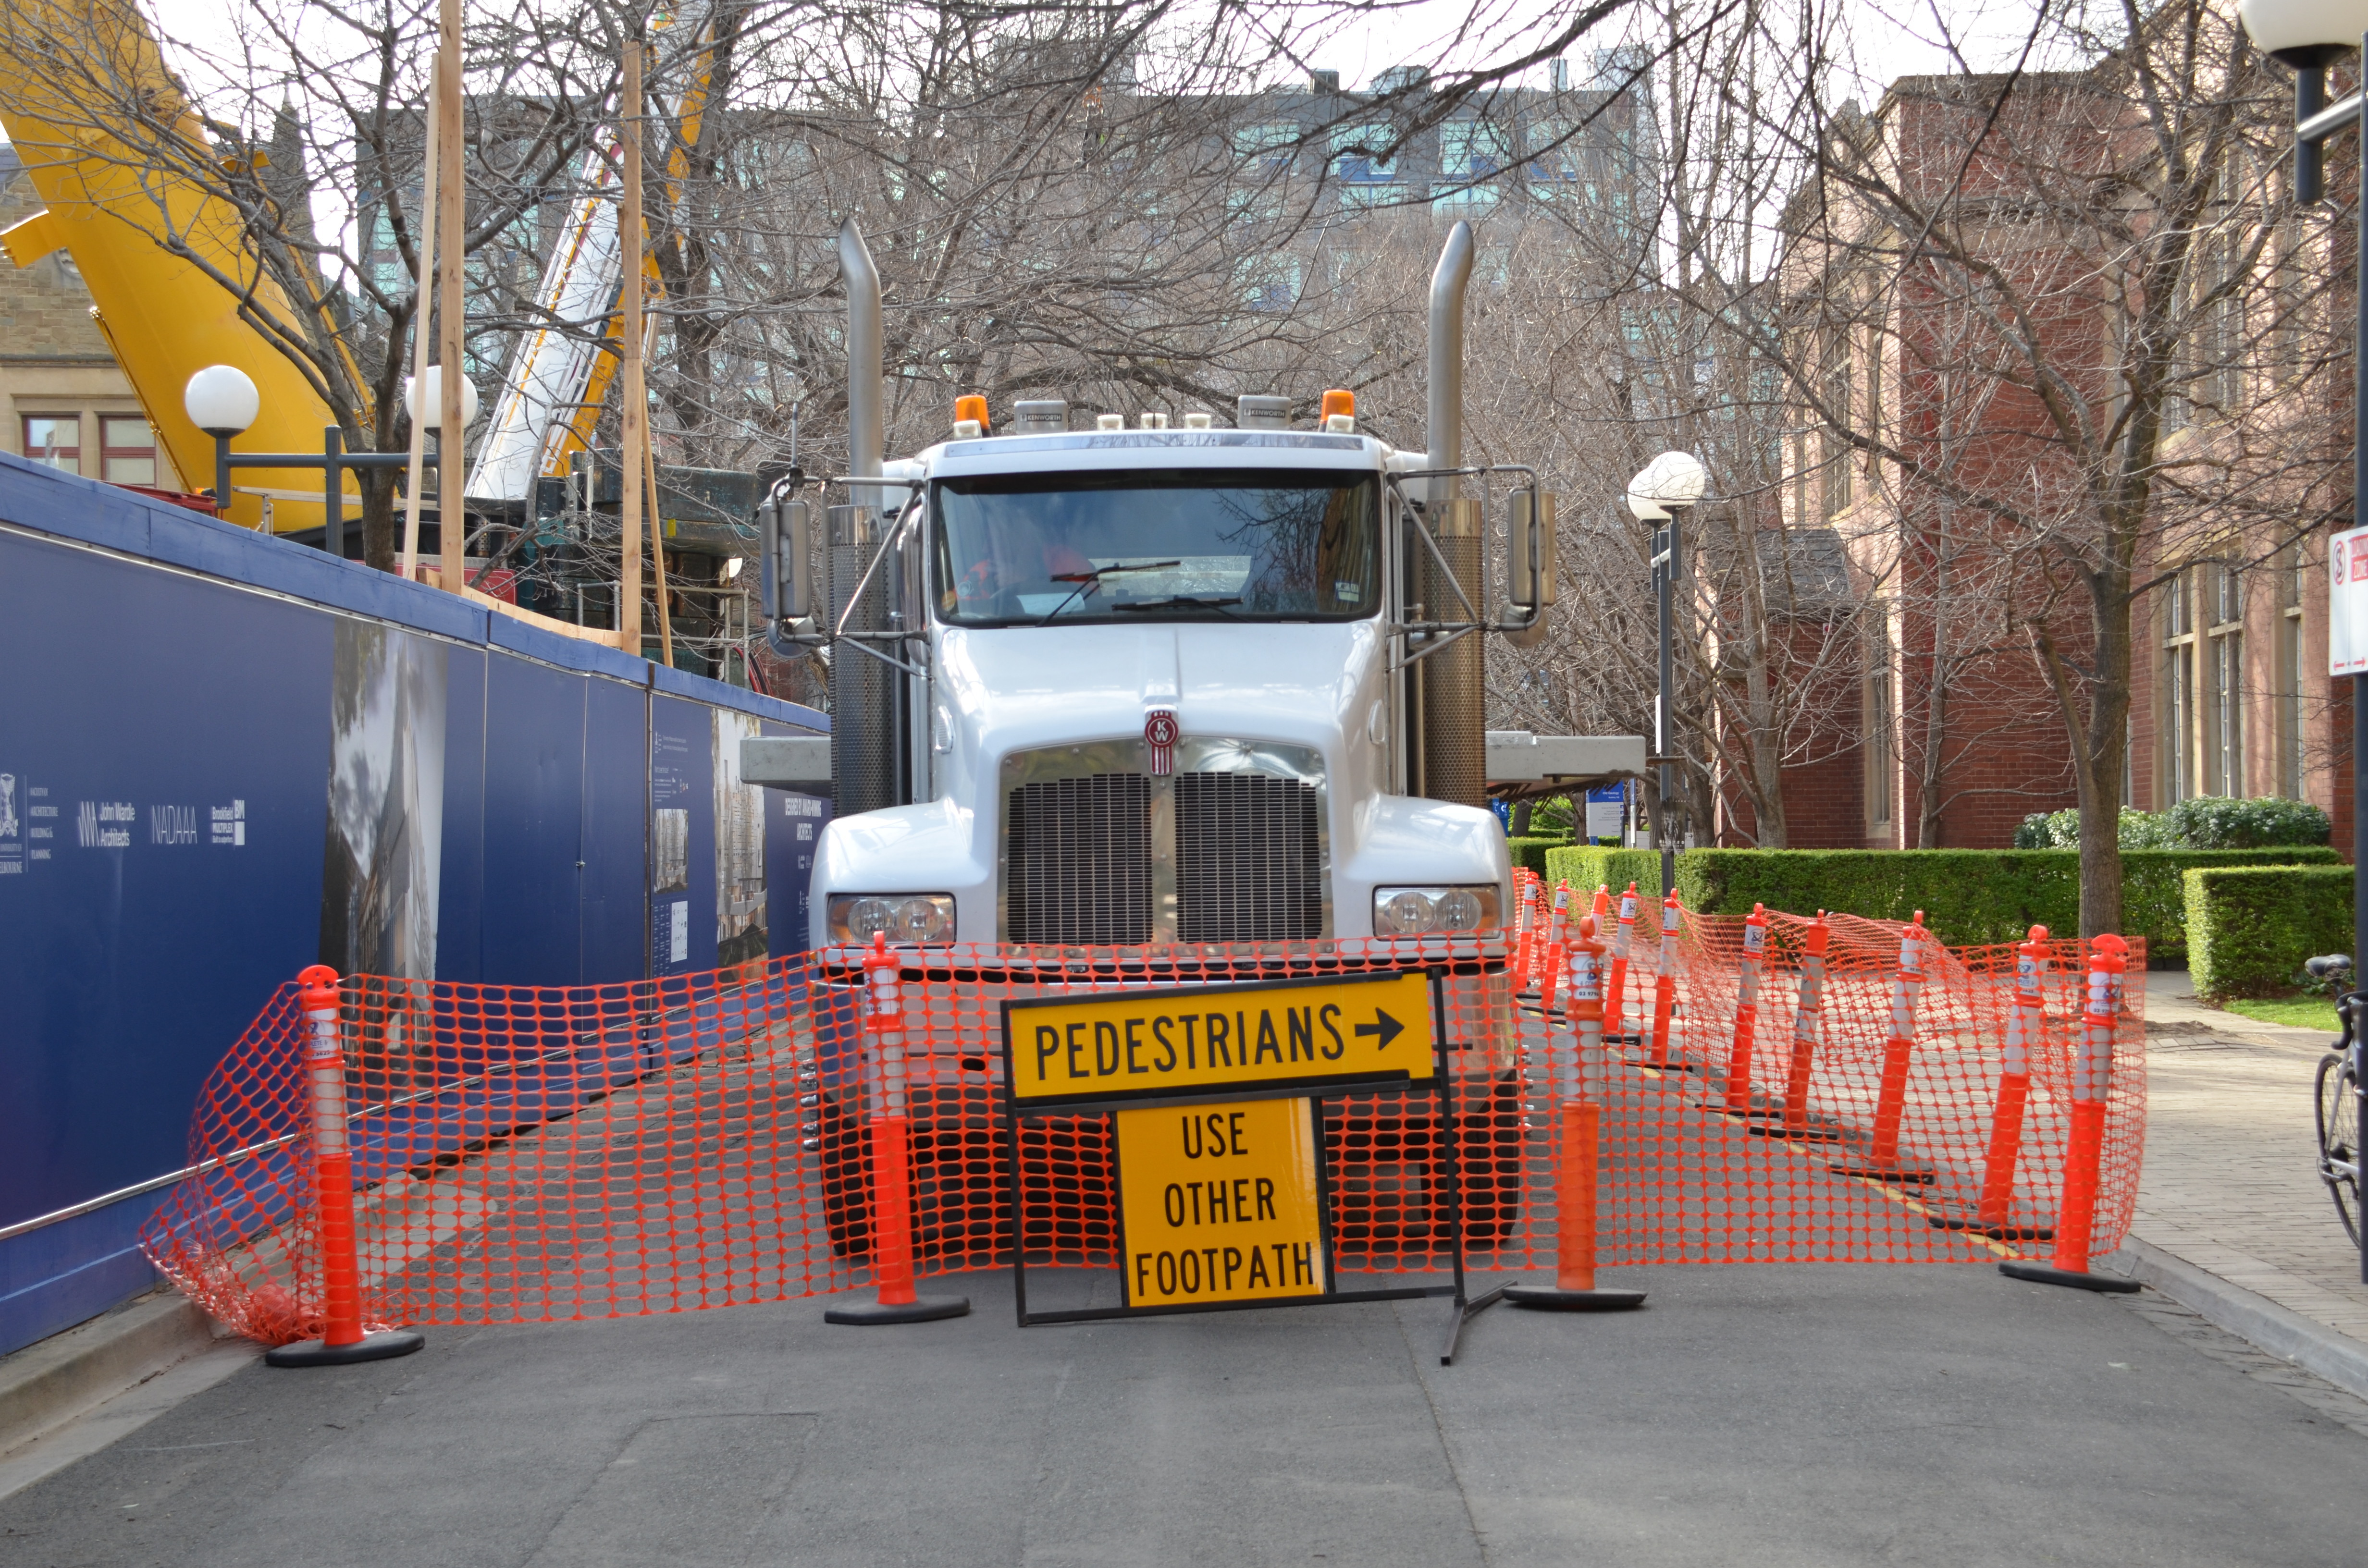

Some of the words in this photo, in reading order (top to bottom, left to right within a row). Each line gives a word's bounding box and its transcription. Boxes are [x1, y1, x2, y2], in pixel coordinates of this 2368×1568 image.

[2351, 538, 2368, 557] LOADIN
[2354, 559, 2367, 578] ZONE
[1158, 722, 1166, 731] K
[1155, 731, 1169, 741] W
[31, 807, 58, 816] ARCHITECTURE
[100, 802, 114, 821] John
[115, 802, 135, 821] Wardle
[212, 806, 234, 820] Brookfield
[235, 800, 245, 819] BM
[785, 798, 798, 816] DESIGNED
[31, 828, 49, 837] BUILDING
[152, 805, 197, 844] NADAAA
[212, 822, 234, 833] MULTIPLEX
[797, 823, 812, 841] ARCHITECTS
[100, 828, 130, 846] Architects
[32, 849, 51, 859] PLANNING
[1036, 1003, 1344, 1080] PEDESTRIANS
[1182, 1112, 1248, 1159] USE
[1164, 1177, 1276, 1227] OTHER
[1135, 1241, 1313, 1297] FOOTPATH
